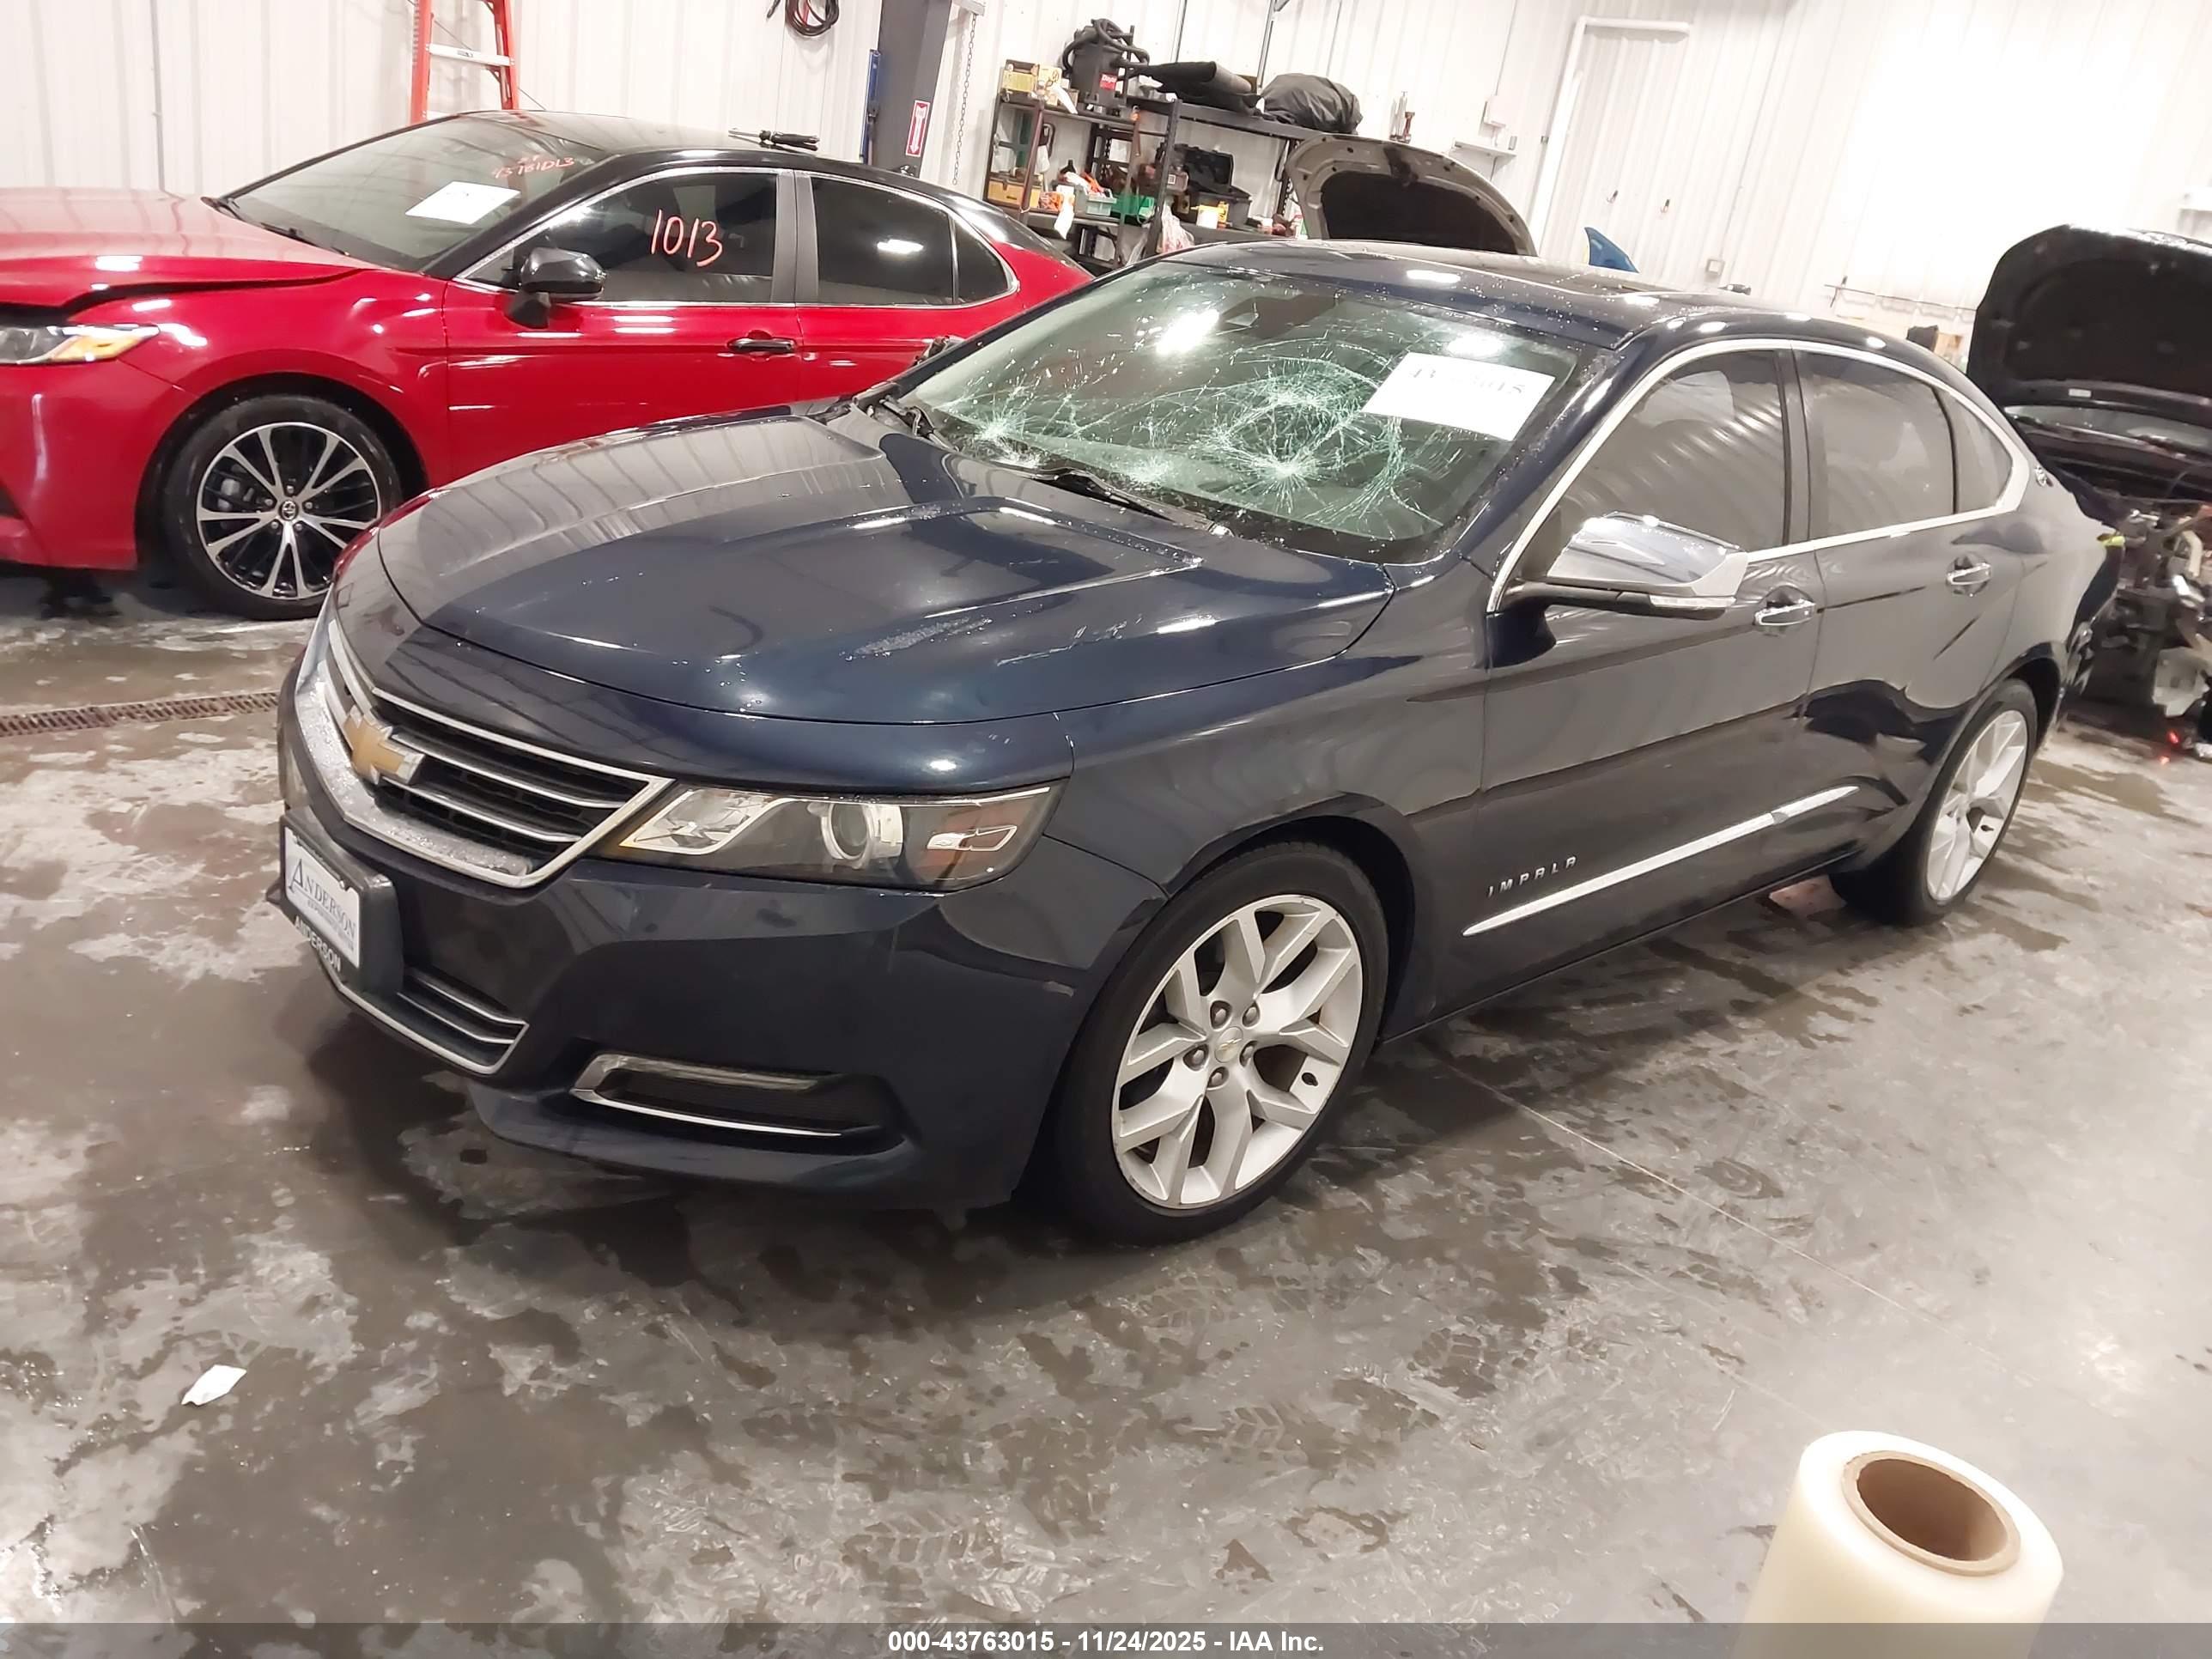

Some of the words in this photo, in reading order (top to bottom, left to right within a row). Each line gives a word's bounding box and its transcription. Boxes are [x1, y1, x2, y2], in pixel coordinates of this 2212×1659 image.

[649, 209, 724, 268] 1013
[288, 858, 356, 940] ANDERSON
[1487, 856, 1577, 898] IMPALA
[295, 915, 343, 973] ANDERSON
